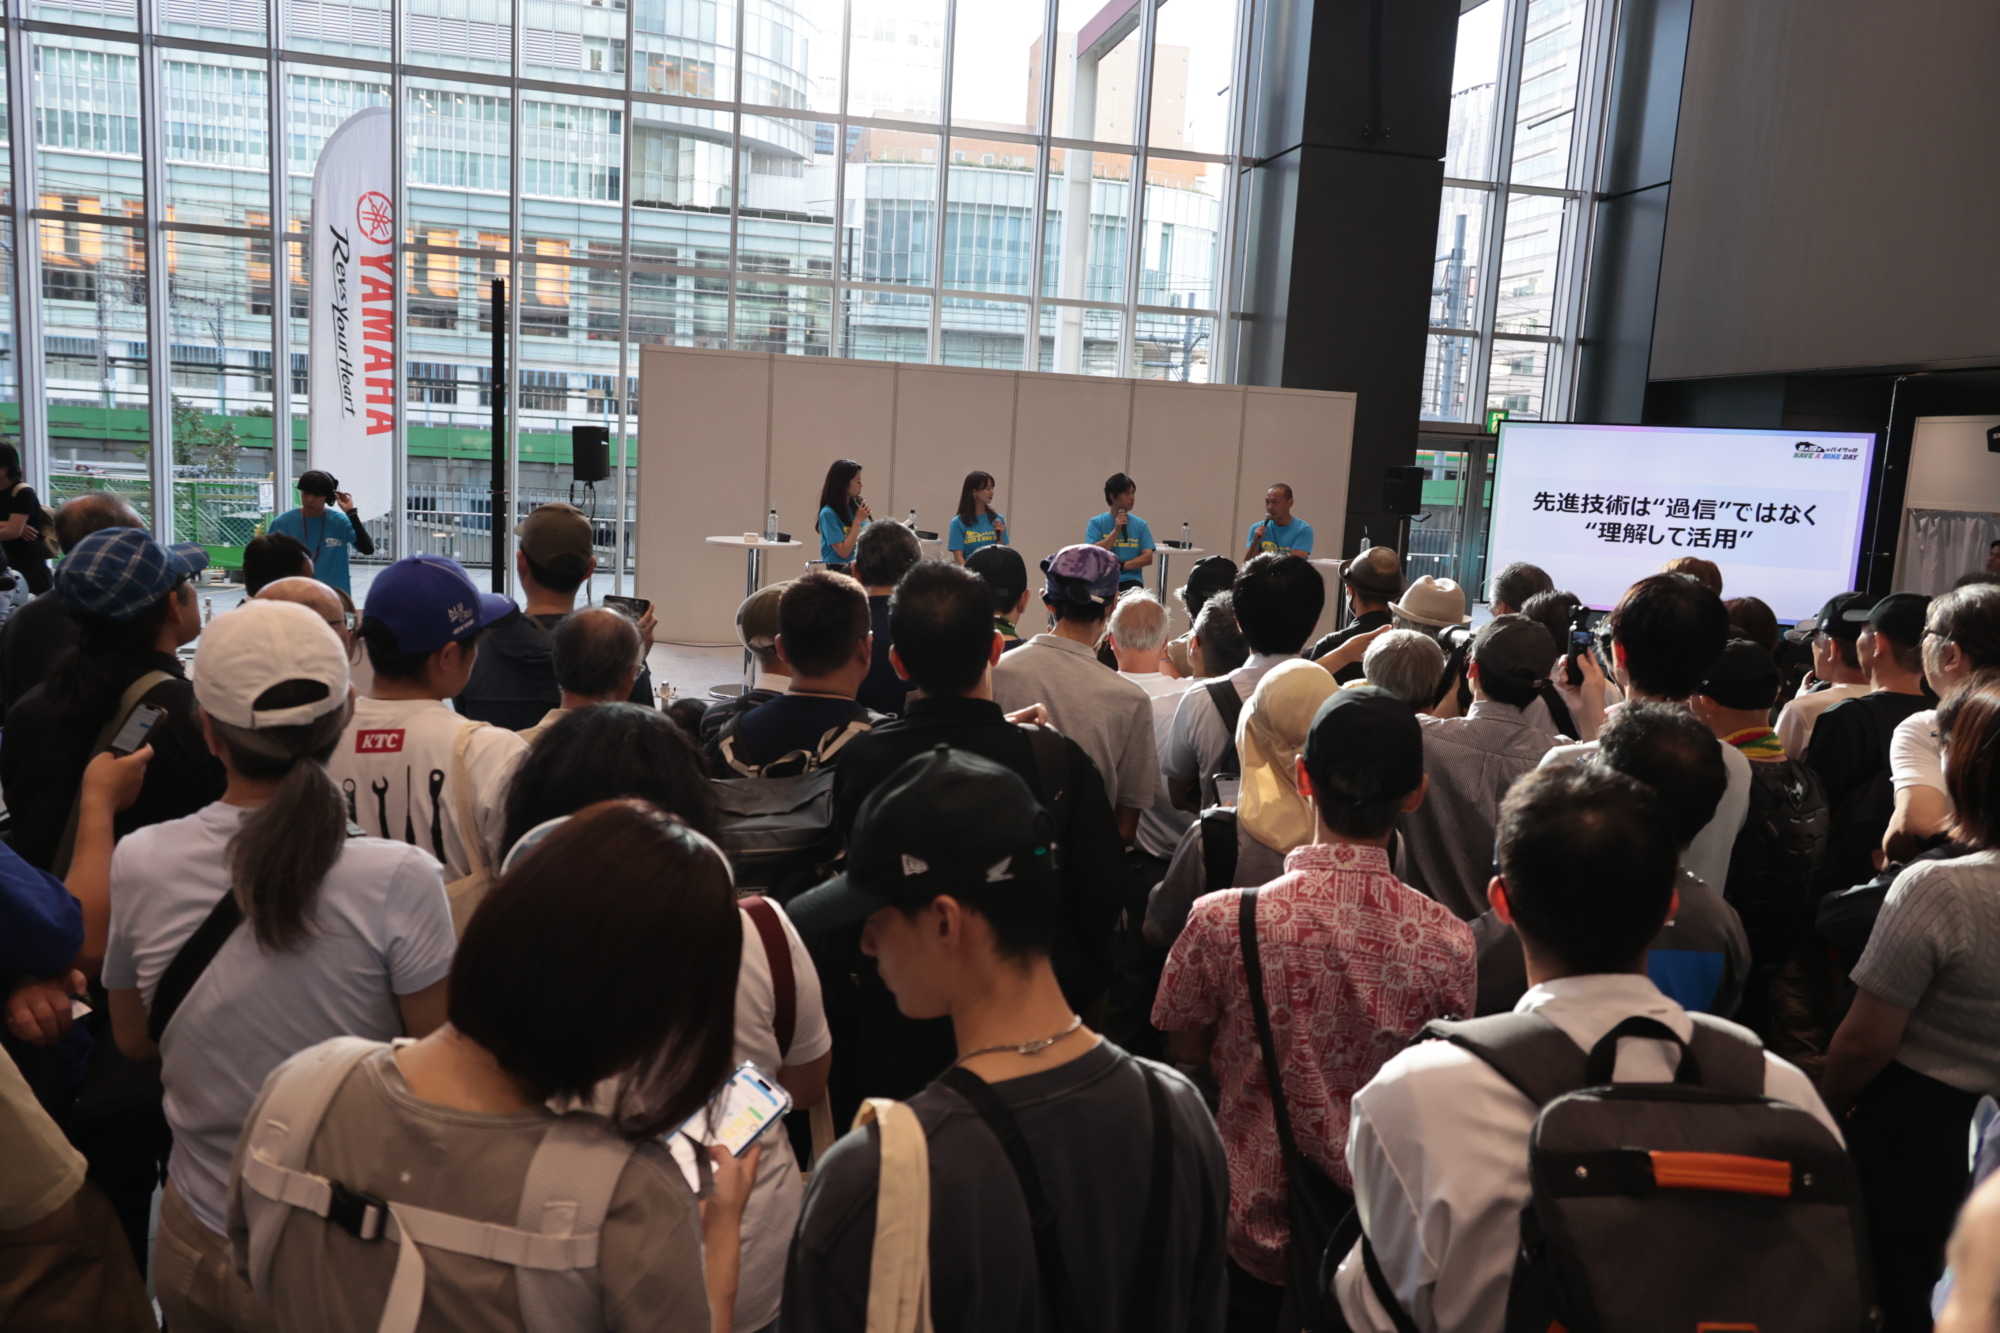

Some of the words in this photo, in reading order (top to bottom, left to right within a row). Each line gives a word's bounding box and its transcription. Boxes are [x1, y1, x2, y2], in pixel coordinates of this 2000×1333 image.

[329, 224, 350, 305] Revs
[331, 302, 350, 359] Your
[359, 253, 394, 436] YAMAHA
[339, 357, 356, 419] Heart
[360, 733, 399, 749] KTC
